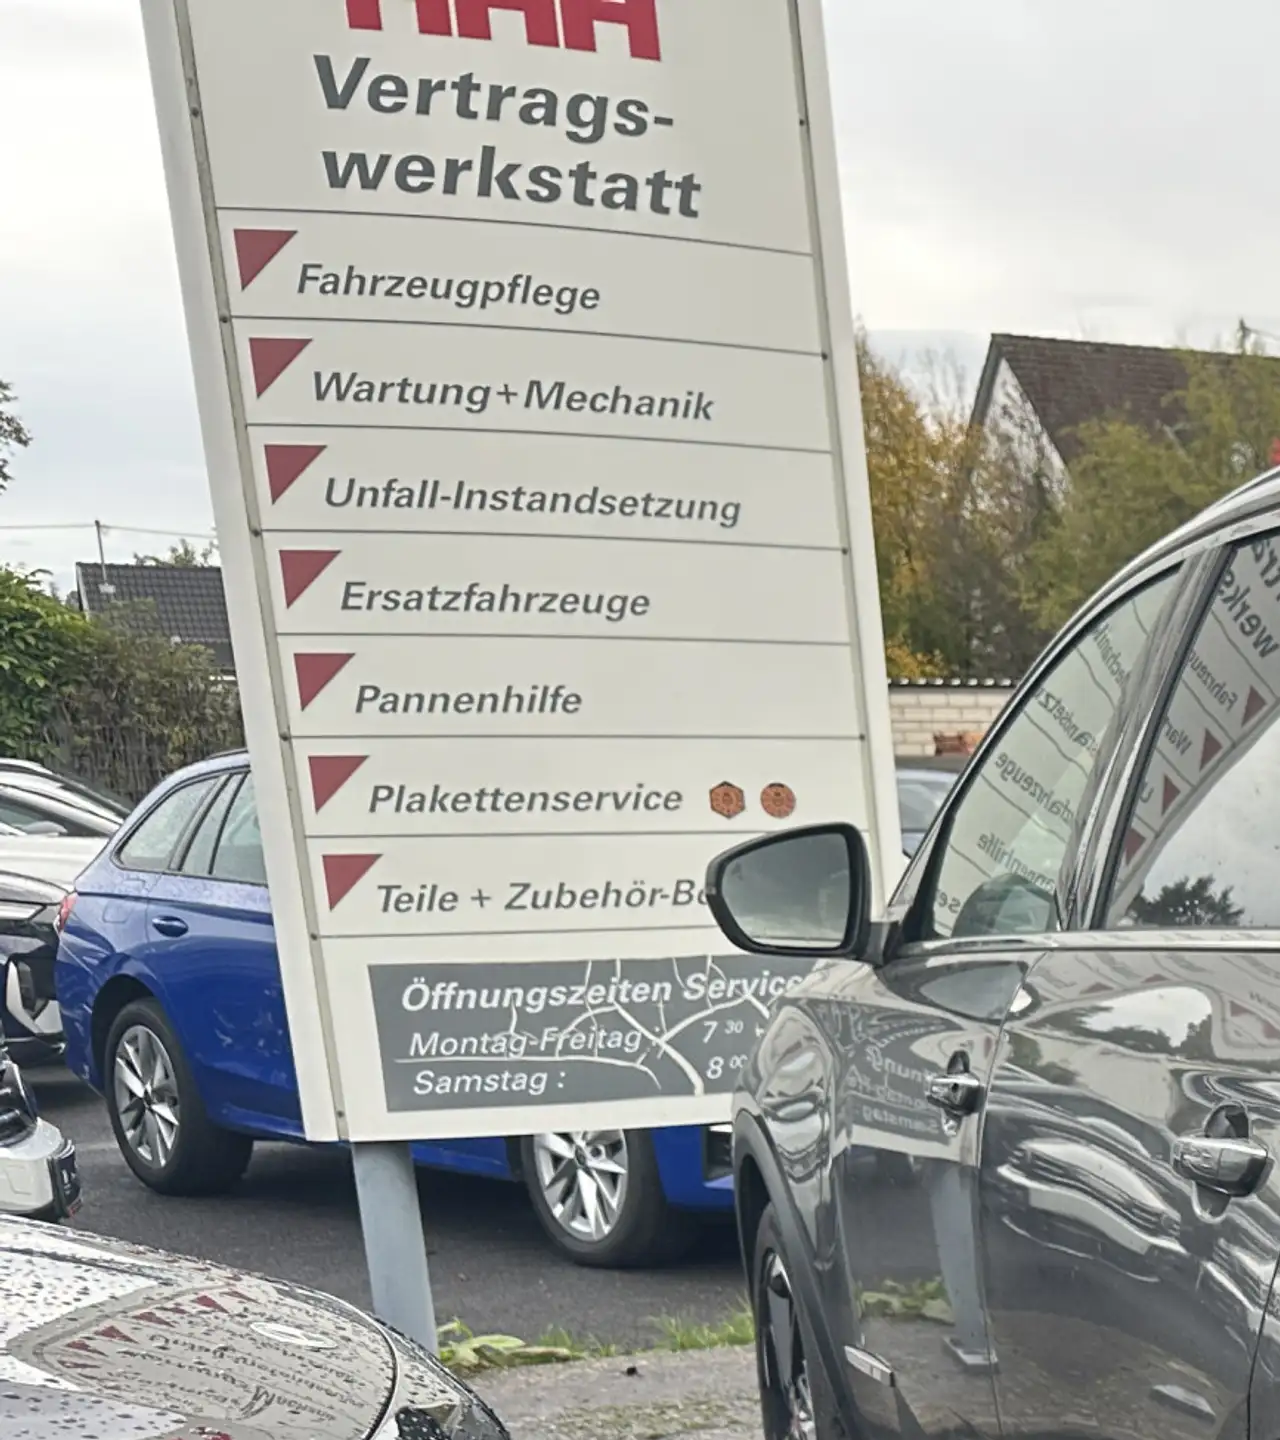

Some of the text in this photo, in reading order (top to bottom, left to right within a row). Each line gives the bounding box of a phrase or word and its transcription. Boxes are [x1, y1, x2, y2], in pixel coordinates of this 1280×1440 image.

[313, 55, 674, 144] Vertrags-
[321, 145, 702, 218] werkstatt
[297, 263, 601, 314] Fahrzeugpflege
[325, 477, 741, 528] Unfall-Instandsetzung
[341, 581, 650, 622] Ersatzfahrzeuge
[355, 685, 583, 714] Pannenhilfe
[368, 783, 684, 814] Plakettenservice
[377, 884, 459, 914] Teile
[402, 977, 672, 1013] Öffnungszeiten
[409, 1027, 642, 1059] Montag-Freitag
[413, 1070, 548, 1095] Samstag
